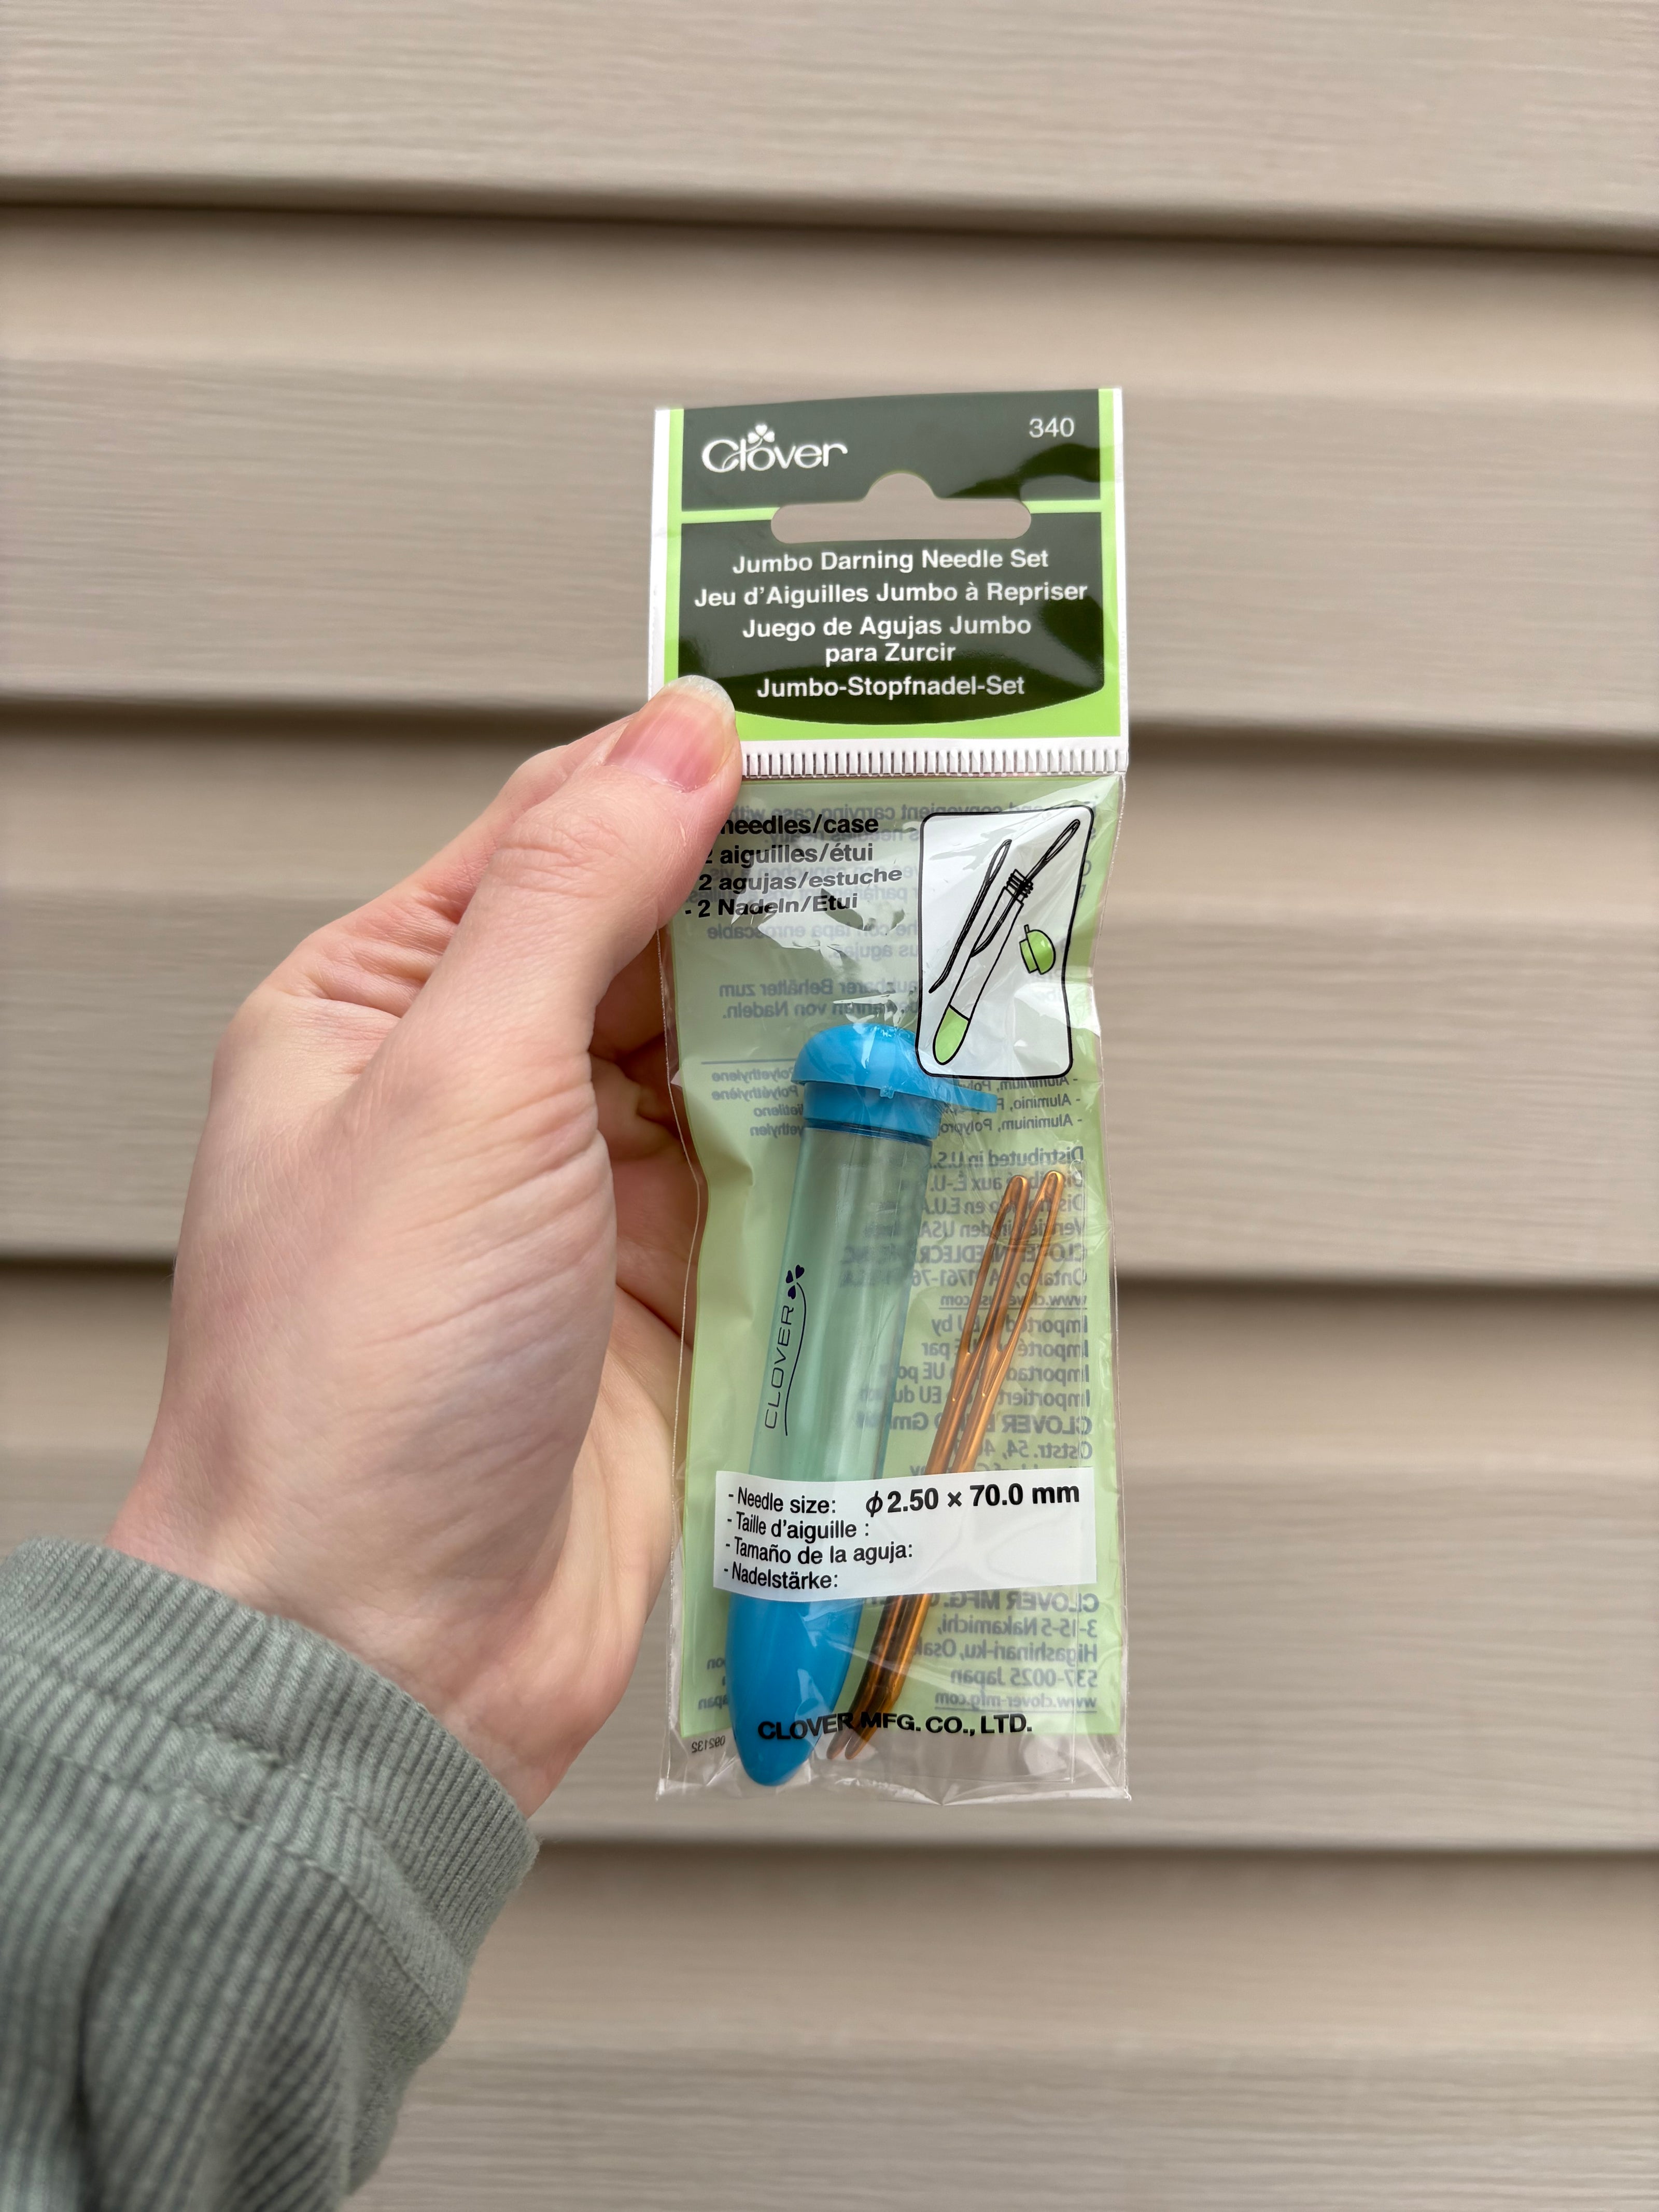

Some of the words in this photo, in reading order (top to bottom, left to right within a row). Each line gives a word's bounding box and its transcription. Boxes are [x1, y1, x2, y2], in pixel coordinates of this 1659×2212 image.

[1029, 417, 1075, 438] 340
[701, 437, 848, 473] Clover
[733, 554, 813, 574] Jumbo
[821, 550, 913, 573] Darning
[922, 549, 1003, 568] Needle
[1010, 548, 1049, 568] Set
[694, 588, 736, 607] Jeu
[876, 583, 958, 602] Jumbo
[965, 581, 979, 601] à
[987, 582, 1088, 605] Repriser
[742, 619, 816, 641] Juego
[823, 617, 852, 637] de
[859, 615, 942, 640] Agujas
[949, 615, 1031, 634] Jumbo
[825, 646, 877, 668] para
[884, 642, 956, 661] Zurcir
[756, 675, 1025, 700] Jumbo-Stopfnadel-Set
[720, 843, 873, 868] aiguilles/étui
[698, 873, 712, 891] 2
[719, 868, 903, 894] agujas/estuche
[697, 899, 711, 918] 2
[718, 893, 858, 916] Nadeln/Etui
[764, 1305, 794, 1429] CLOVER
[737, 1486, 784, 1513] Needle
[790, 1495, 836, 1514] size:
[969, 1483, 1023, 1506] 70.0
[1032, 1485, 1079, 1504] mm
[736, 1511, 767, 1535] Taille
[734, 1535, 791, 1564] Tamaño
[797, 1546, 823, 1565] de
[830, 1545, 847, 1563] la
[853, 1541, 913, 1566] aguja:
[732, 1561, 838, 1590] Nadelstärke:
[757, 1712, 854, 1740] CLOVER
[860, 1711, 922, 1732] MFG.
[925, 1716, 976, 1737] CO.,
[981, 1713, 1033, 1734] LTD.
